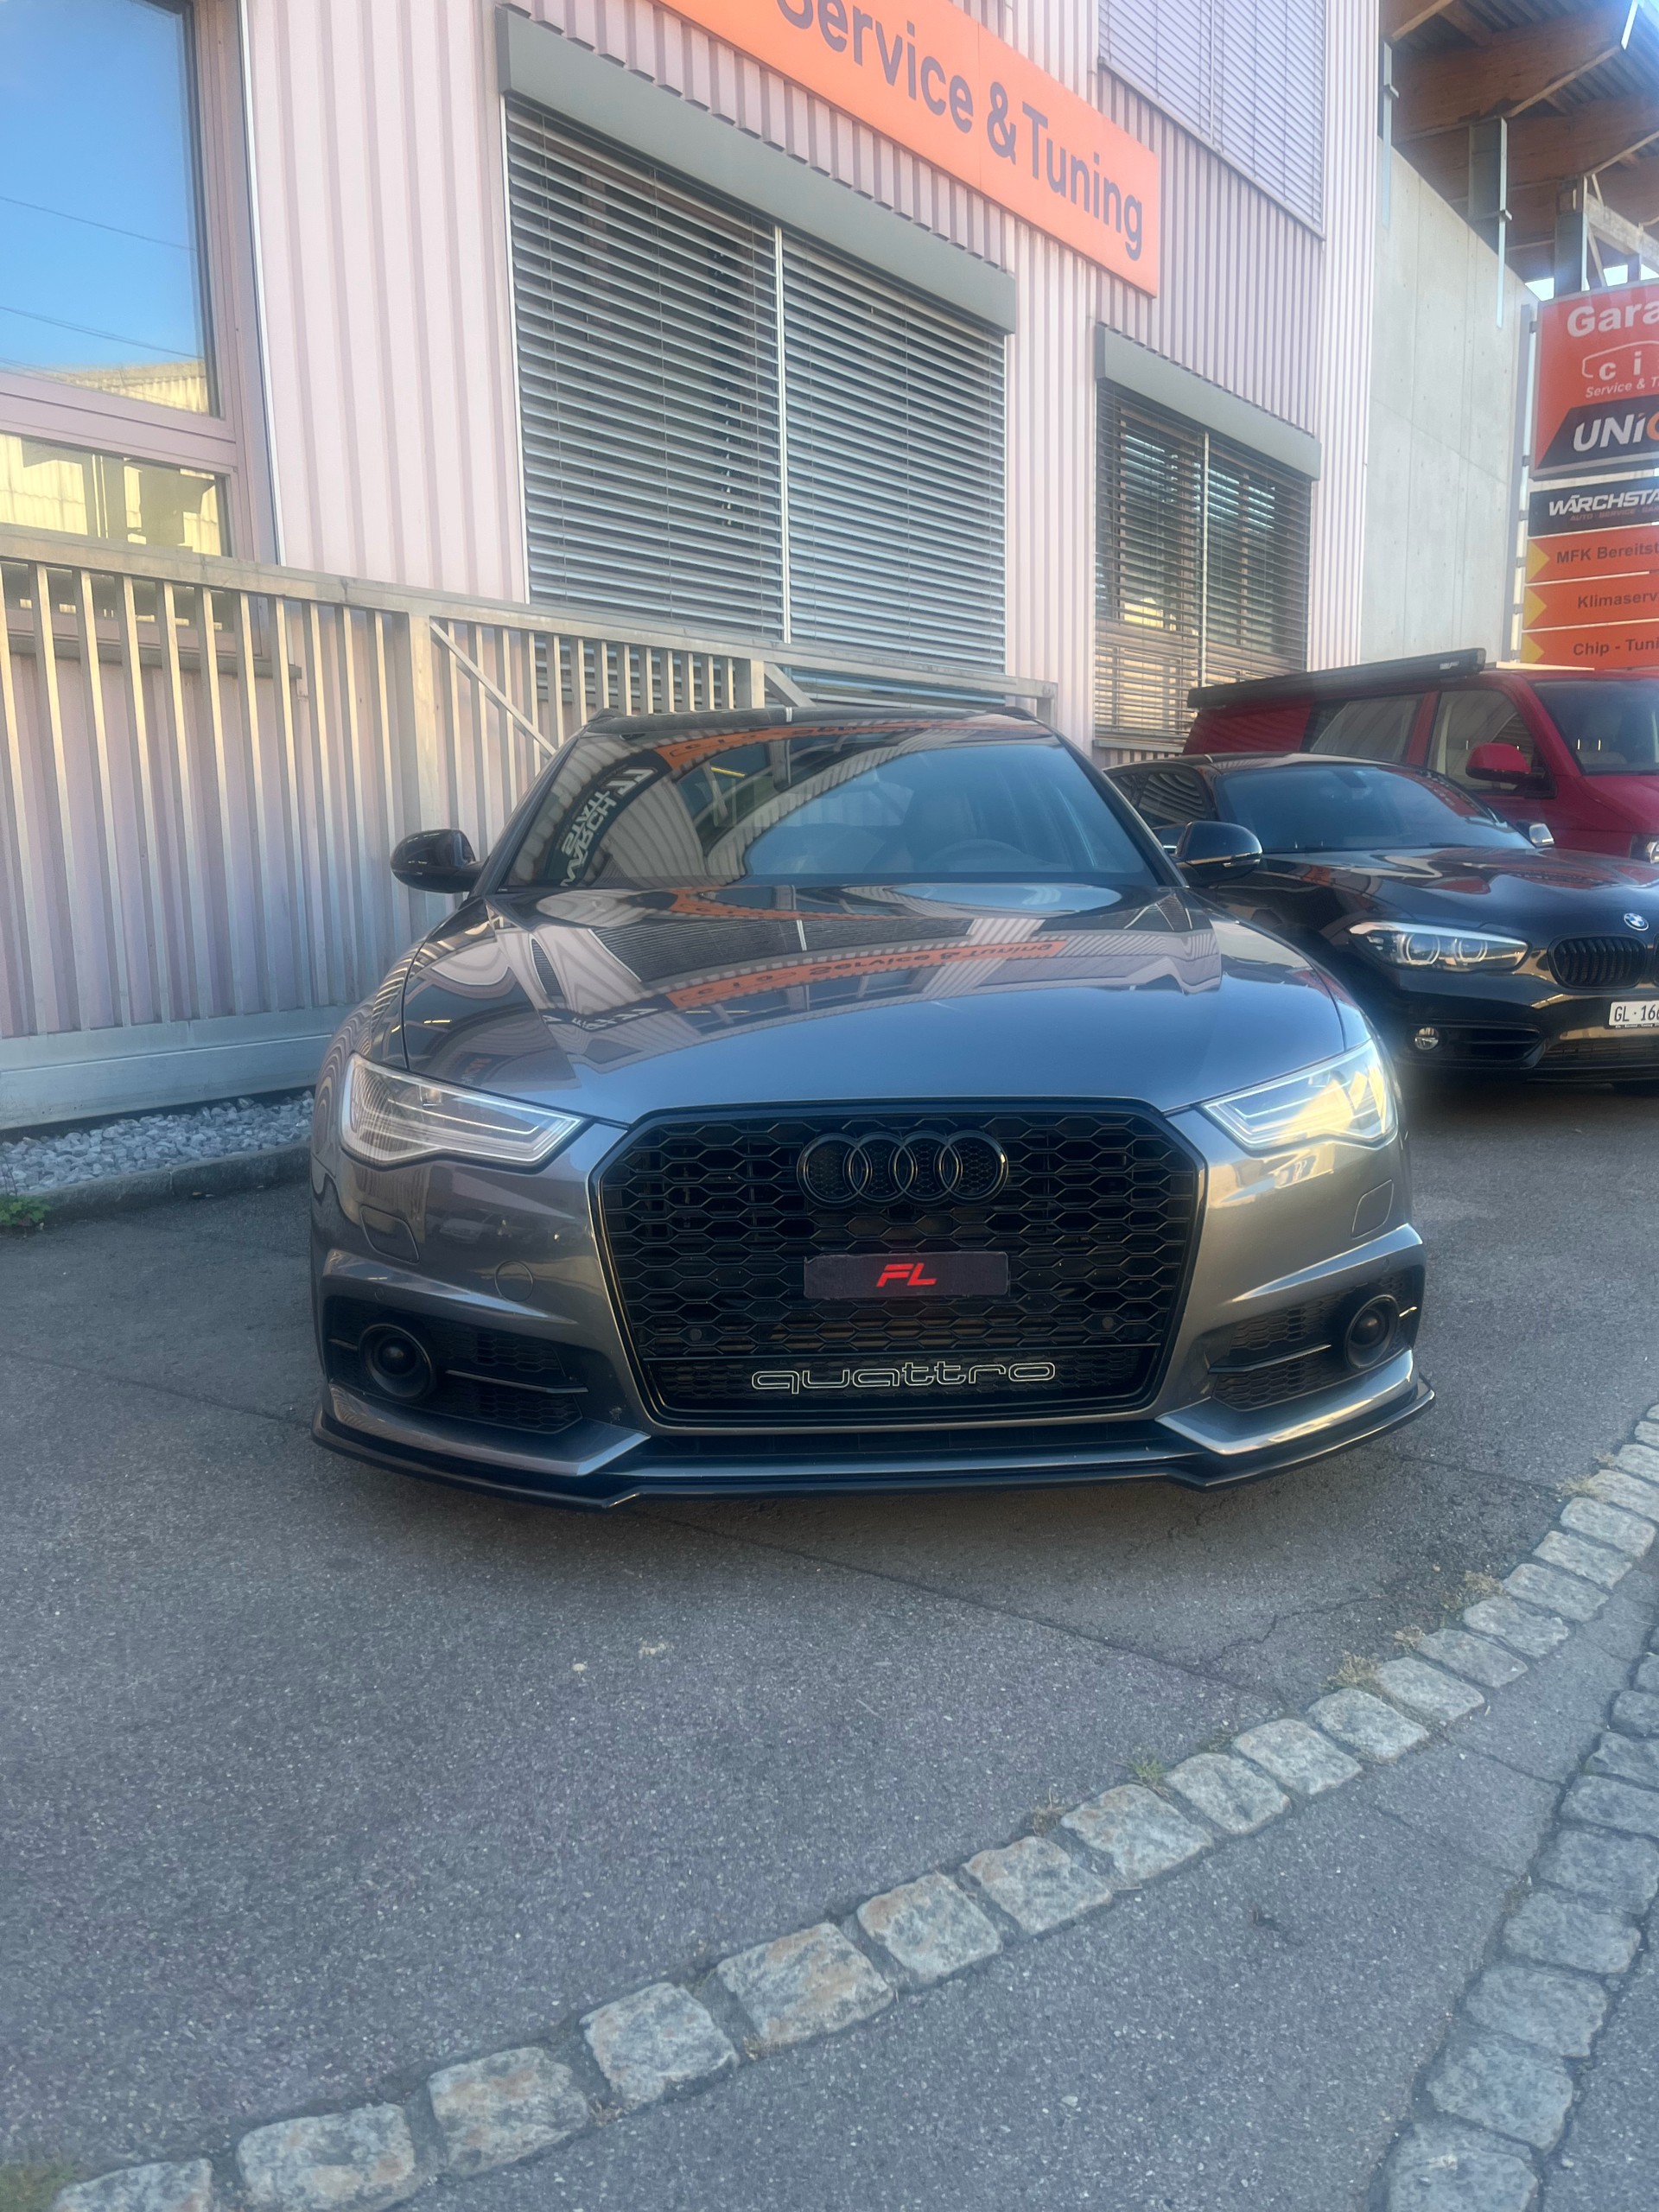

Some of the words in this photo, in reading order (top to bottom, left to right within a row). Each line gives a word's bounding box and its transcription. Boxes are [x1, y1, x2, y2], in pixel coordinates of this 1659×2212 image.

[987, 81, 1017, 166] &
[1022, 100, 1142, 261] Tuning
[1567, 300, 1659, 338] Gara
[1585, 381, 1633, 398] Service
[1636, 378, 1646, 391] &
[1556, 548, 1592, 563] MFK
[1578, 592, 1658, 608] Klimaserv
[1573, 642, 1610, 657] Chip
[1614, 1006, 1630, 1021] GL
[875, 1262, 937, 1287] FL
[751, 1361, 1056, 1395] quattro
